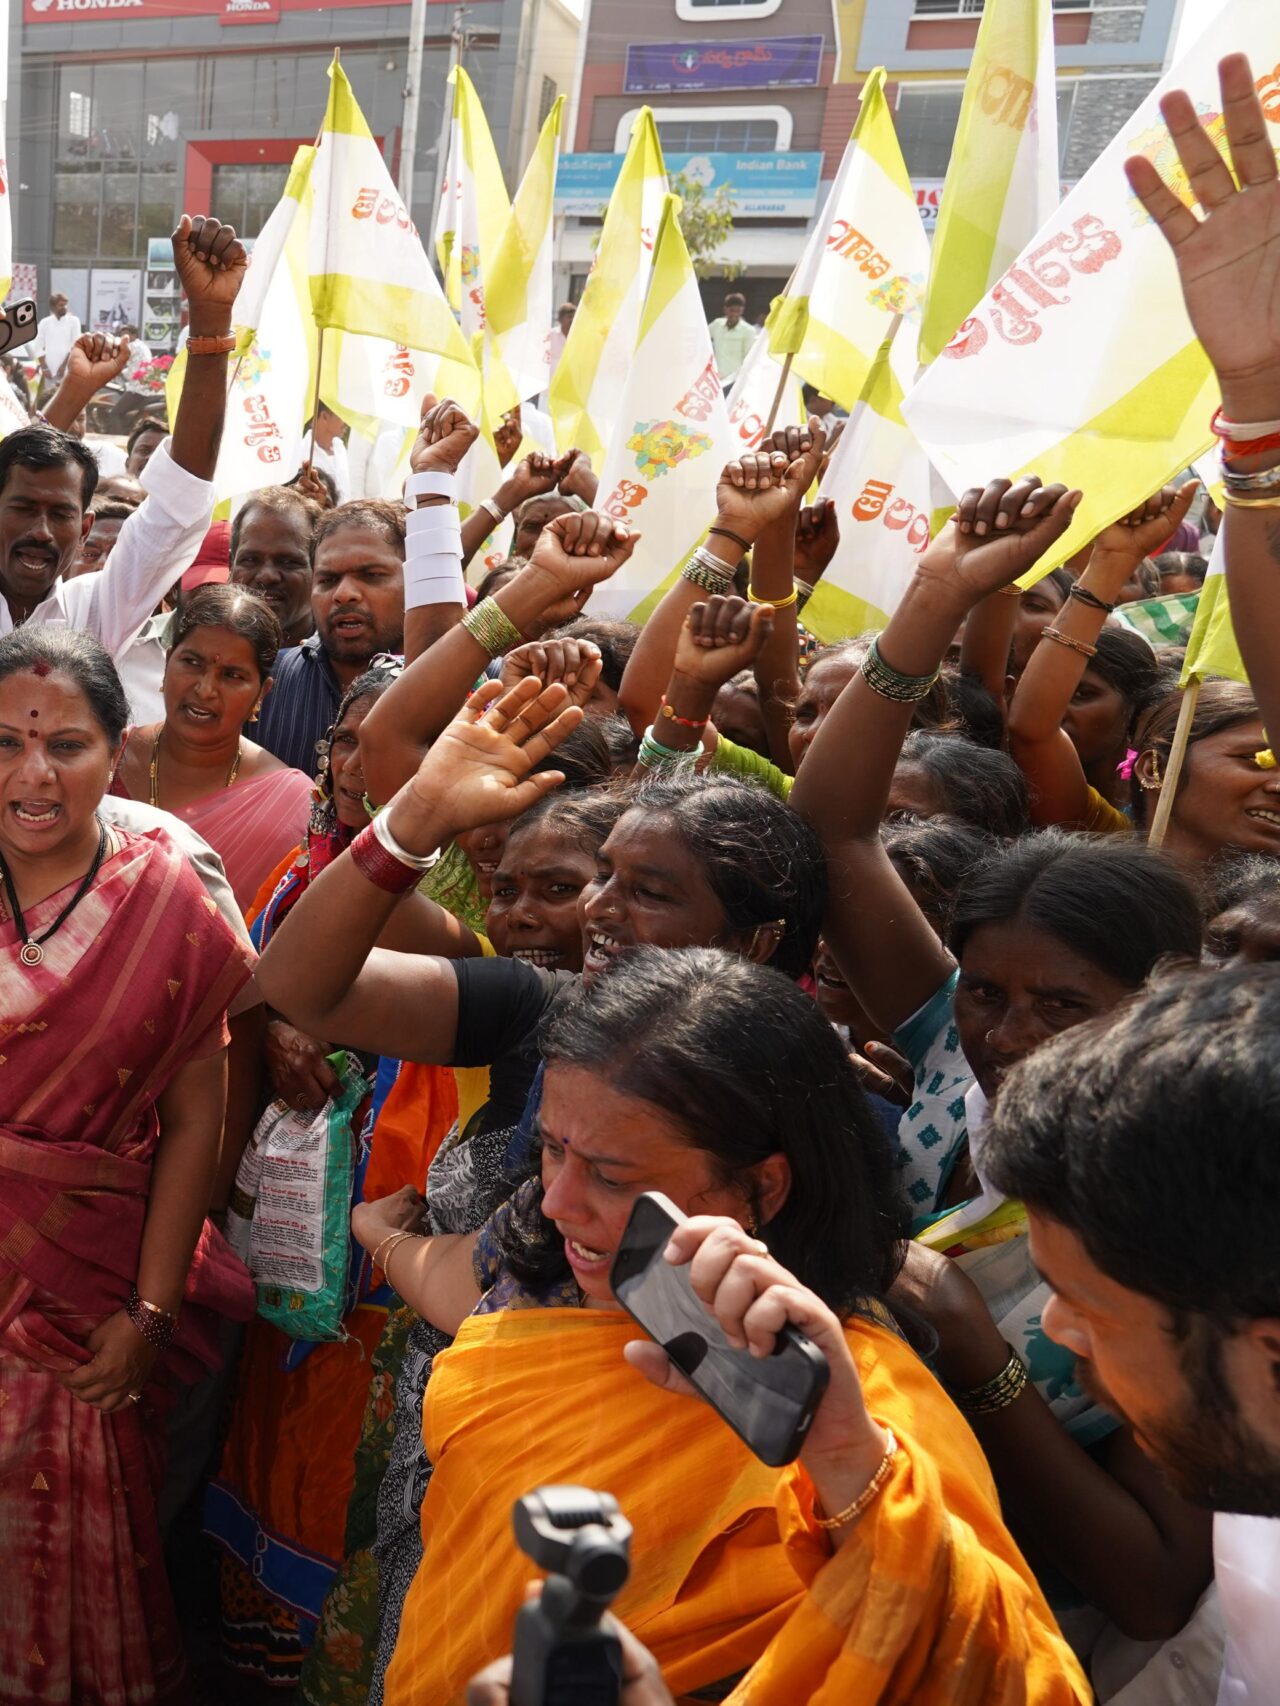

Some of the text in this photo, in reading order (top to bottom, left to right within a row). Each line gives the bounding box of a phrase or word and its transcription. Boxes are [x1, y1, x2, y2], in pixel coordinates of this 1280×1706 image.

[55, 0, 144, 11] HONDA
[226, 2, 271, 12] HONDA
[736, 159, 808, 170] Indian Bank
